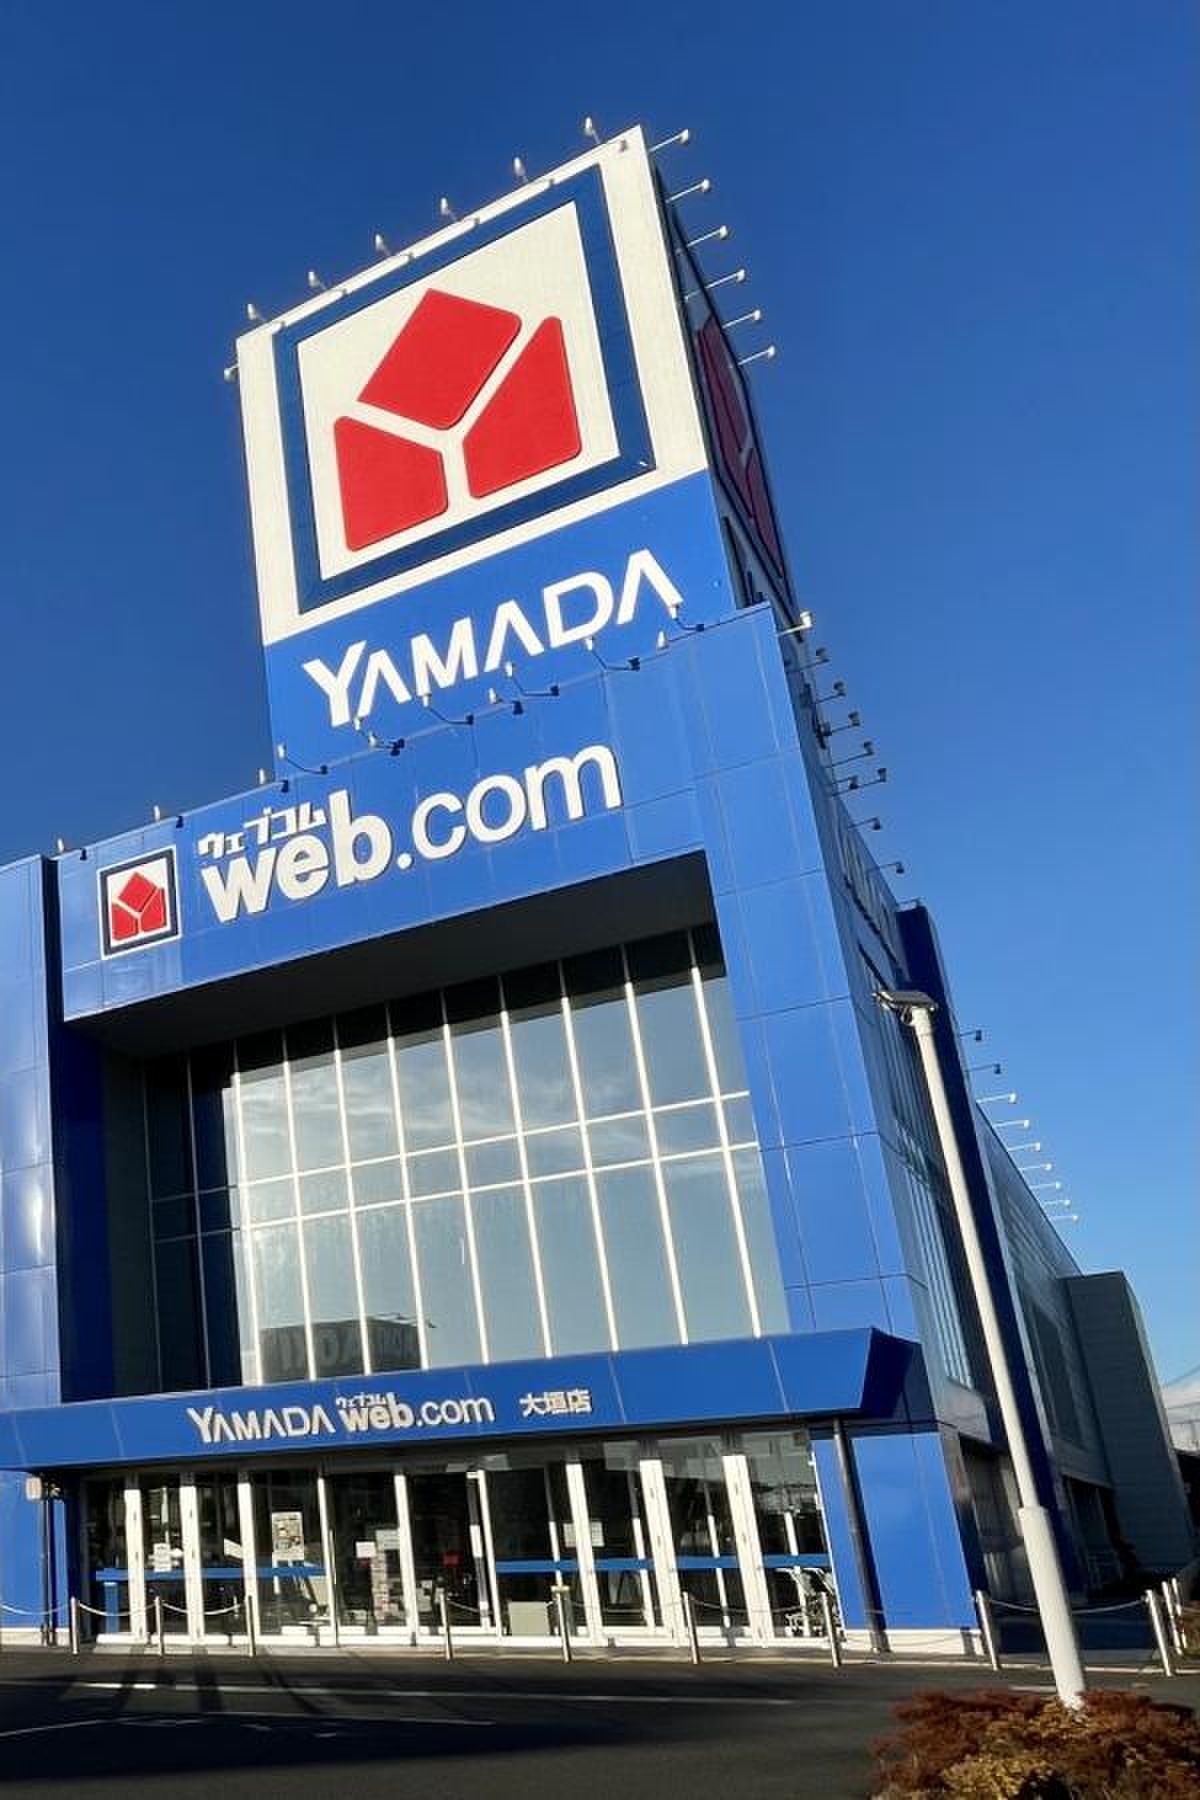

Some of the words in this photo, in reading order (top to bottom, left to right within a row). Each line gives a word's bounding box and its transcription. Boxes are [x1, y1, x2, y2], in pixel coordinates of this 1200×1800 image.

[303, 548, 684, 728] YAMADA
[198, 801, 326, 858] ウェブコム
[202, 744, 623, 924] web.com
[187, 1406, 336, 1443] YAMADA
[338, 1391, 496, 1433] web.com
[519, 1388, 592, 1418] 大垣店
